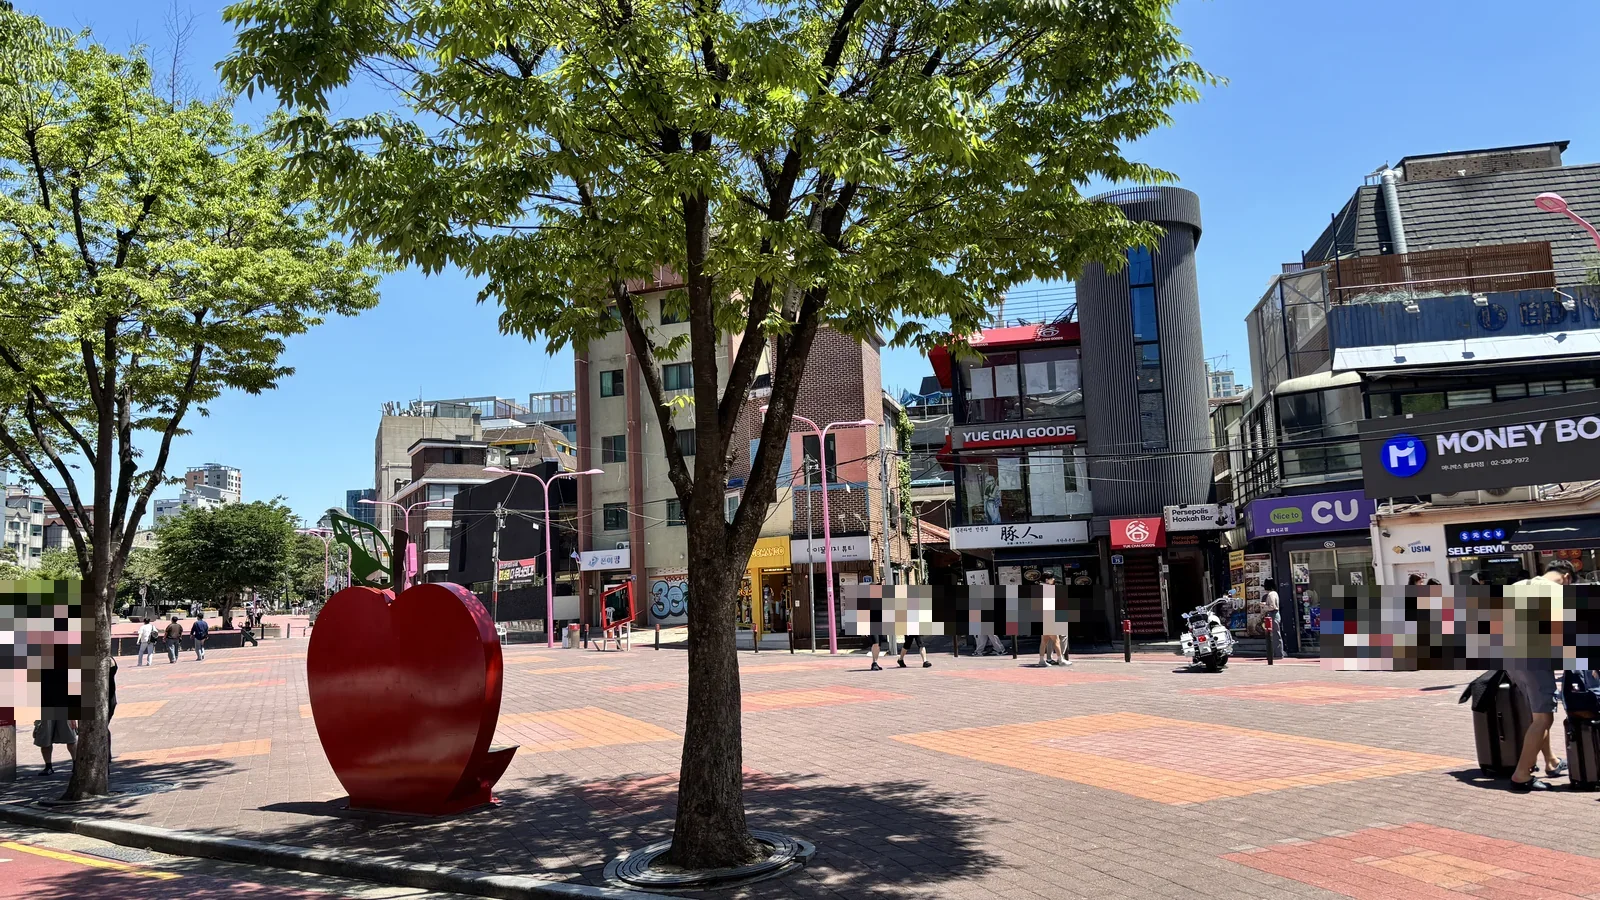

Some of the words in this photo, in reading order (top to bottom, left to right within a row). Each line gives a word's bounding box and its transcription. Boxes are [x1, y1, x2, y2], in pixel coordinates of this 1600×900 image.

[963, 431, 990, 442] YUE
[993, 428, 1023, 440] CHAI
[1027, 425, 1076, 438] GOODS
[1436, 422, 1547, 455] MONEY
[1311, 499, 1358, 524] CU
[1448, 546, 1472, 555] SELF
